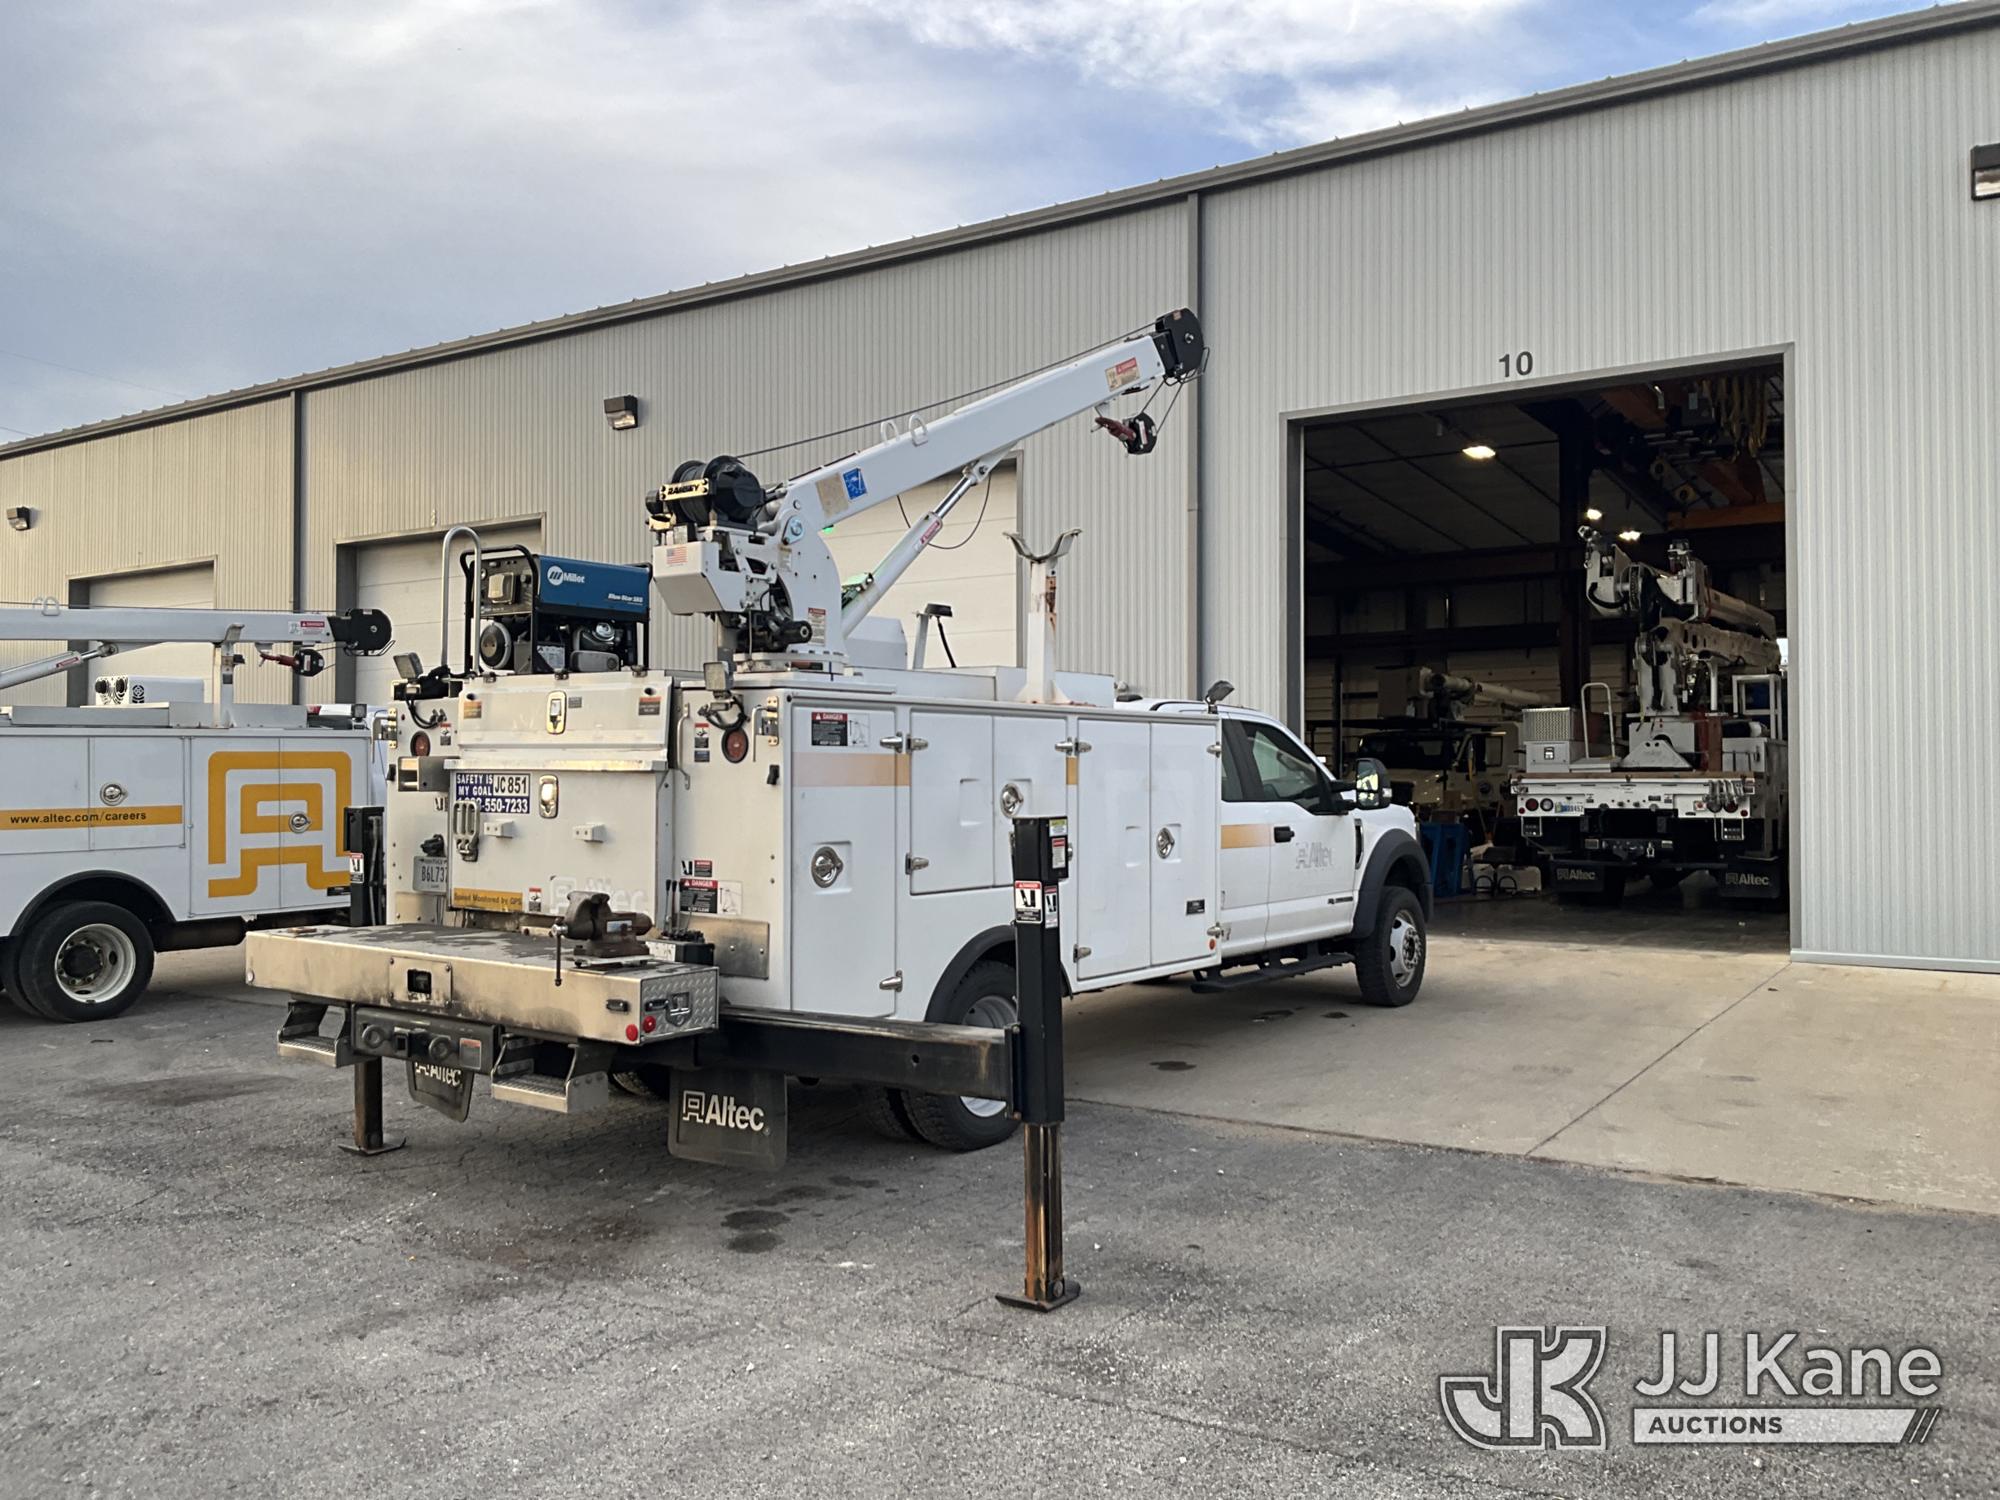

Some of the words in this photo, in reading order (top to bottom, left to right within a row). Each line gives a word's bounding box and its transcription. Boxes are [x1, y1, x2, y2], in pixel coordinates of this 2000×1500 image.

[1499, 351, 1533, 378] 10
[563, 572, 586, 583] Miller
[456, 774, 483, 784] SAFETY
[486, 775, 493, 785] IS
[458, 785, 470, 796] MY
[473, 786, 493, 796] GOAL
[10, 811, 147, 823] www.altec.com/careers
[1569, 869, 1596, 880] Altec
[1738, 873, 1770, 886] Altec
[691, 880, 713, 888] DANGER
[704, 1094, 765, 1132] Altec
